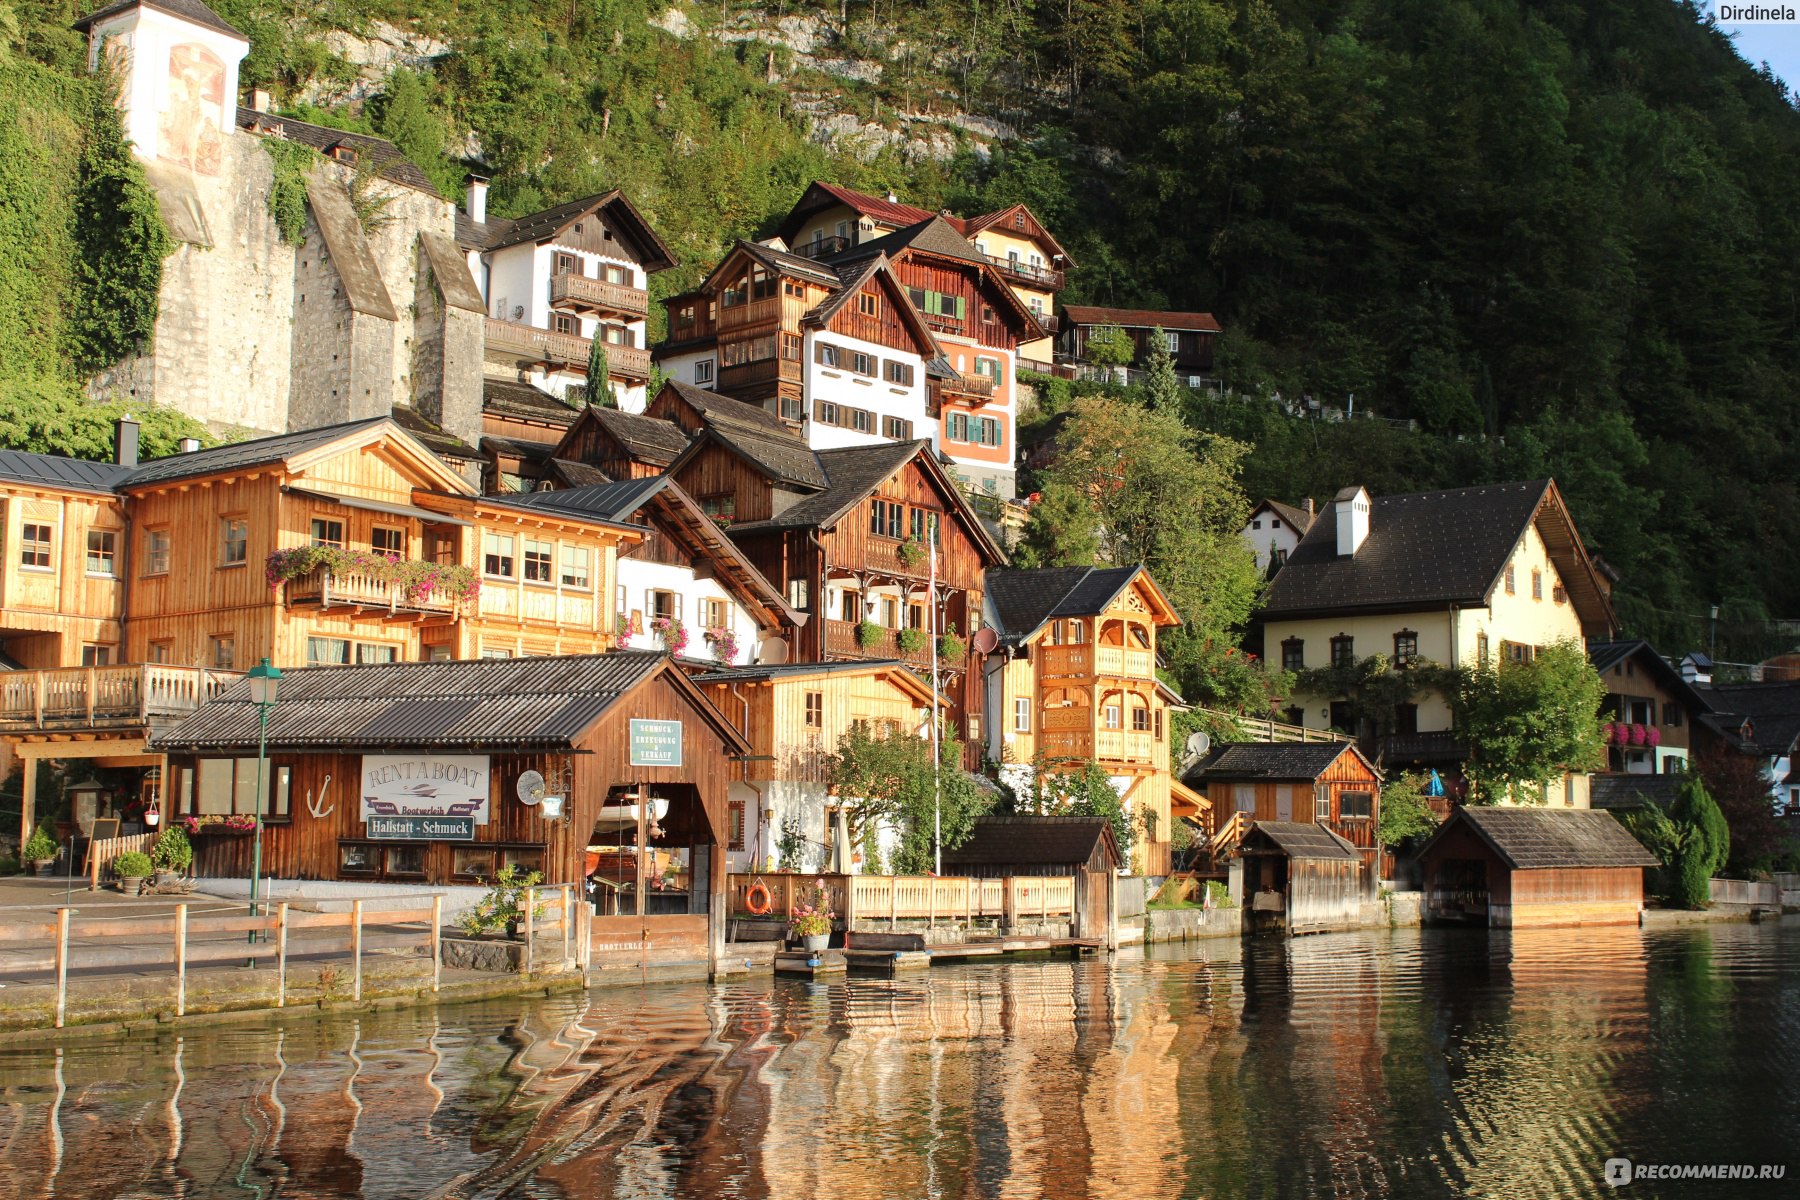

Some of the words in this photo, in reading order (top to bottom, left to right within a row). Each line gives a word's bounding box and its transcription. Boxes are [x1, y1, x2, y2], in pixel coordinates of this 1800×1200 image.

[640, 750, 672, 759] VERKAUF
[368, 762, 414, 789] RENT
[416, 761, 428, 779] A
[432, 762, 482, 789] BOAT
[401, 805, 445, 815] Bootverleih
[372, 820, 414, 834] Hallstatt
[422, 820, 469, 835] Schmuck
